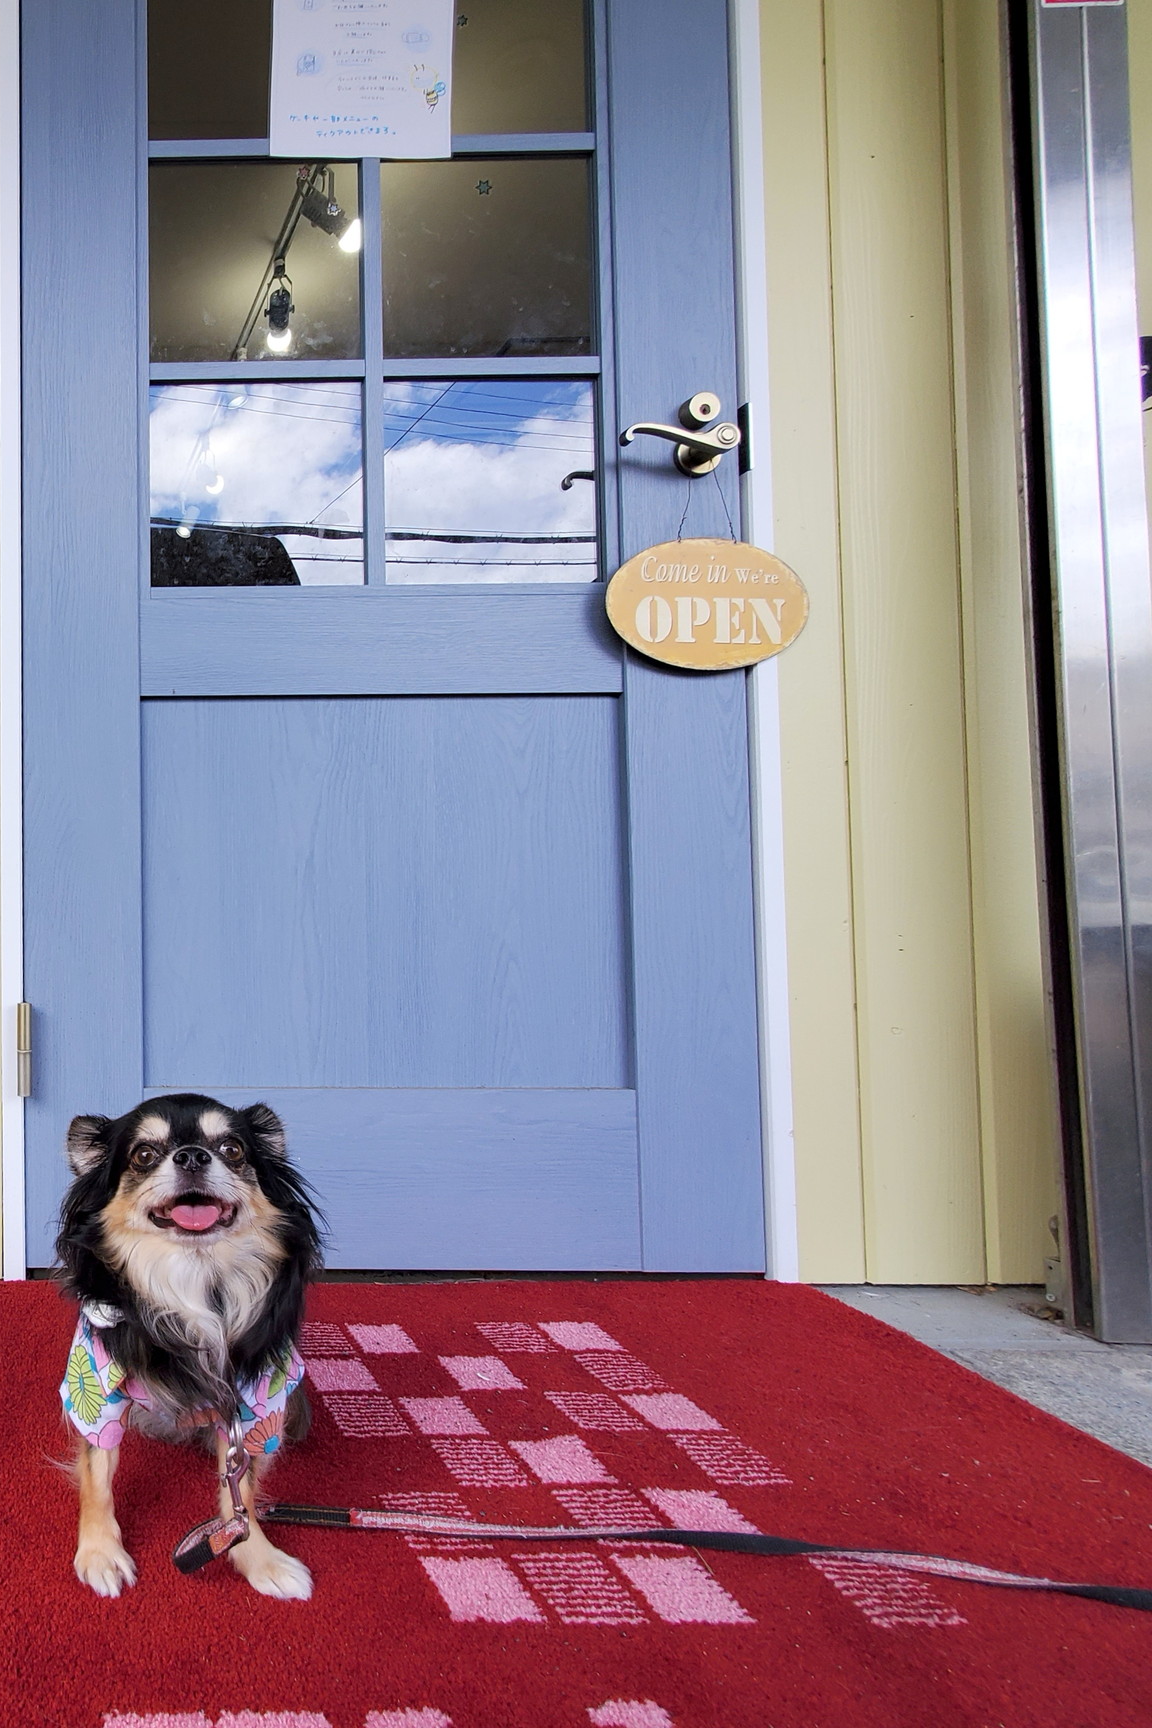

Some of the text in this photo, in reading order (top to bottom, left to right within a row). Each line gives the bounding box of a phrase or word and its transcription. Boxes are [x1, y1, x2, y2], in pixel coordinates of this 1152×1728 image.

[641, 556, 701, 584] Come
[707, 555, 729, 584] in
[635, 595, 786, 645] OPEN
